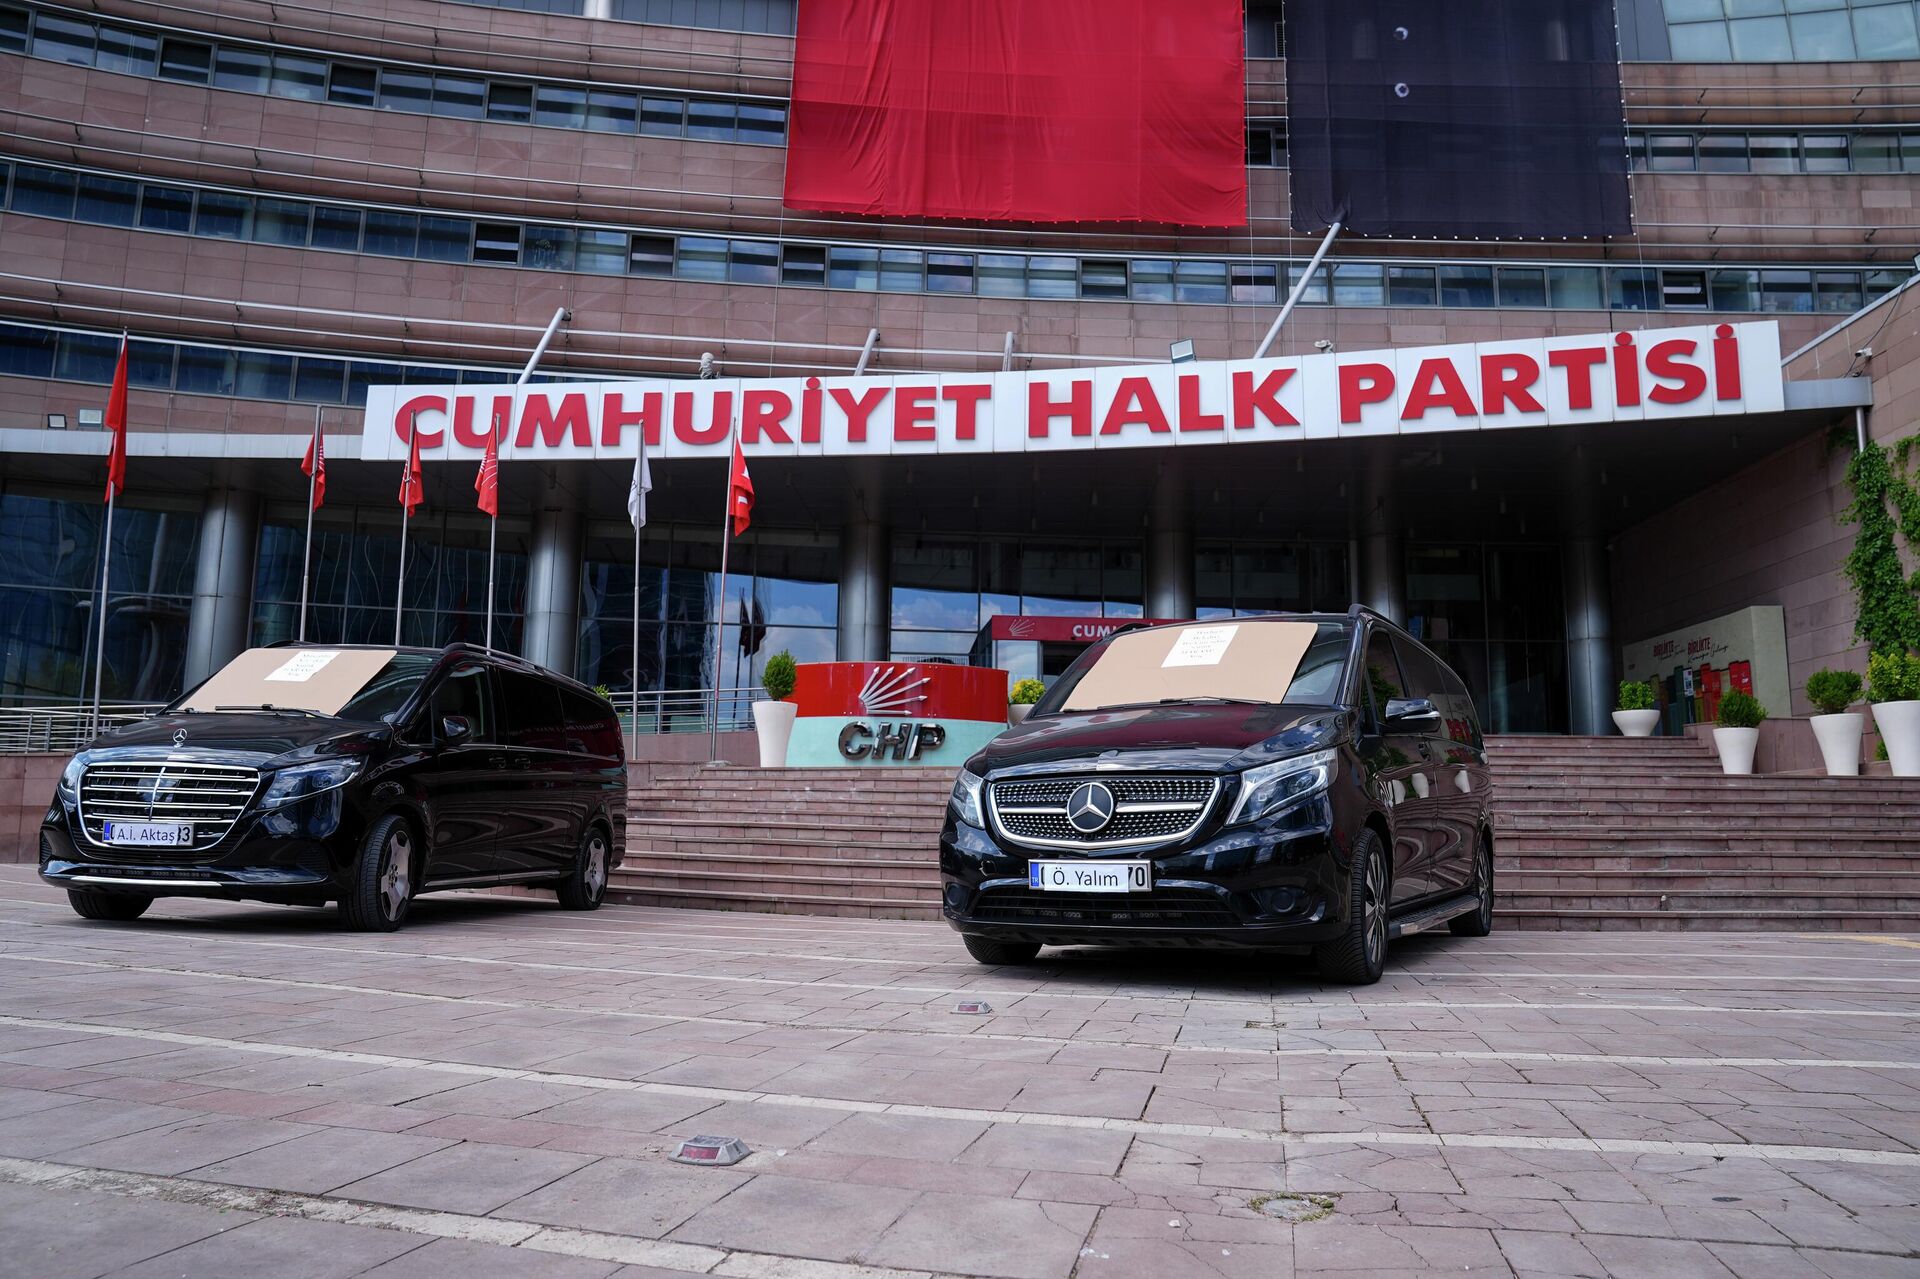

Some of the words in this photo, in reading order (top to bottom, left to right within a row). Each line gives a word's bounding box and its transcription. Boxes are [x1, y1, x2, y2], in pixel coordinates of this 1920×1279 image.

[394, 376, 992, 449] CUMHURİYET
[1028, 367, 1301, 439] HALK
[1338, 323, 1742, 424] PARTİSİ
[838, 721, 946, 761] CHP
[117, 826, 136, 841] A.İ.
[140, 828, 175, 844] Aktaş
[1053, 867, 1070, 886] Ö.
[1075, 870, 1119, 886] Yalım
